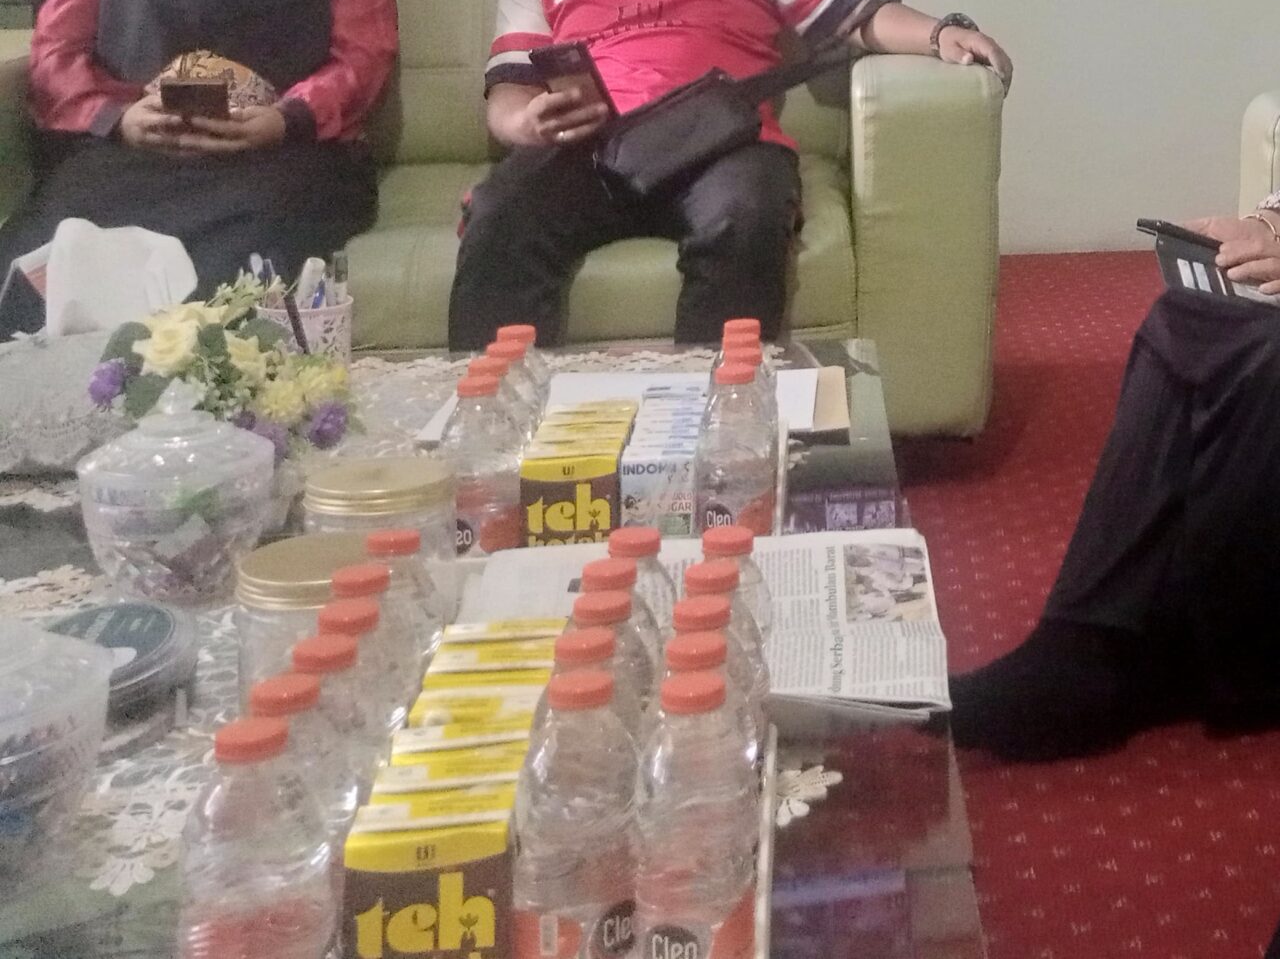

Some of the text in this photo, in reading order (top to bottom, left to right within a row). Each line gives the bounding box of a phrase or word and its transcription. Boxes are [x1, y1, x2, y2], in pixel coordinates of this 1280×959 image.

[527, 483, 611, 534] teh
[354, 871, 496, 959] teh
[603, 915, 633, 948] Cle
